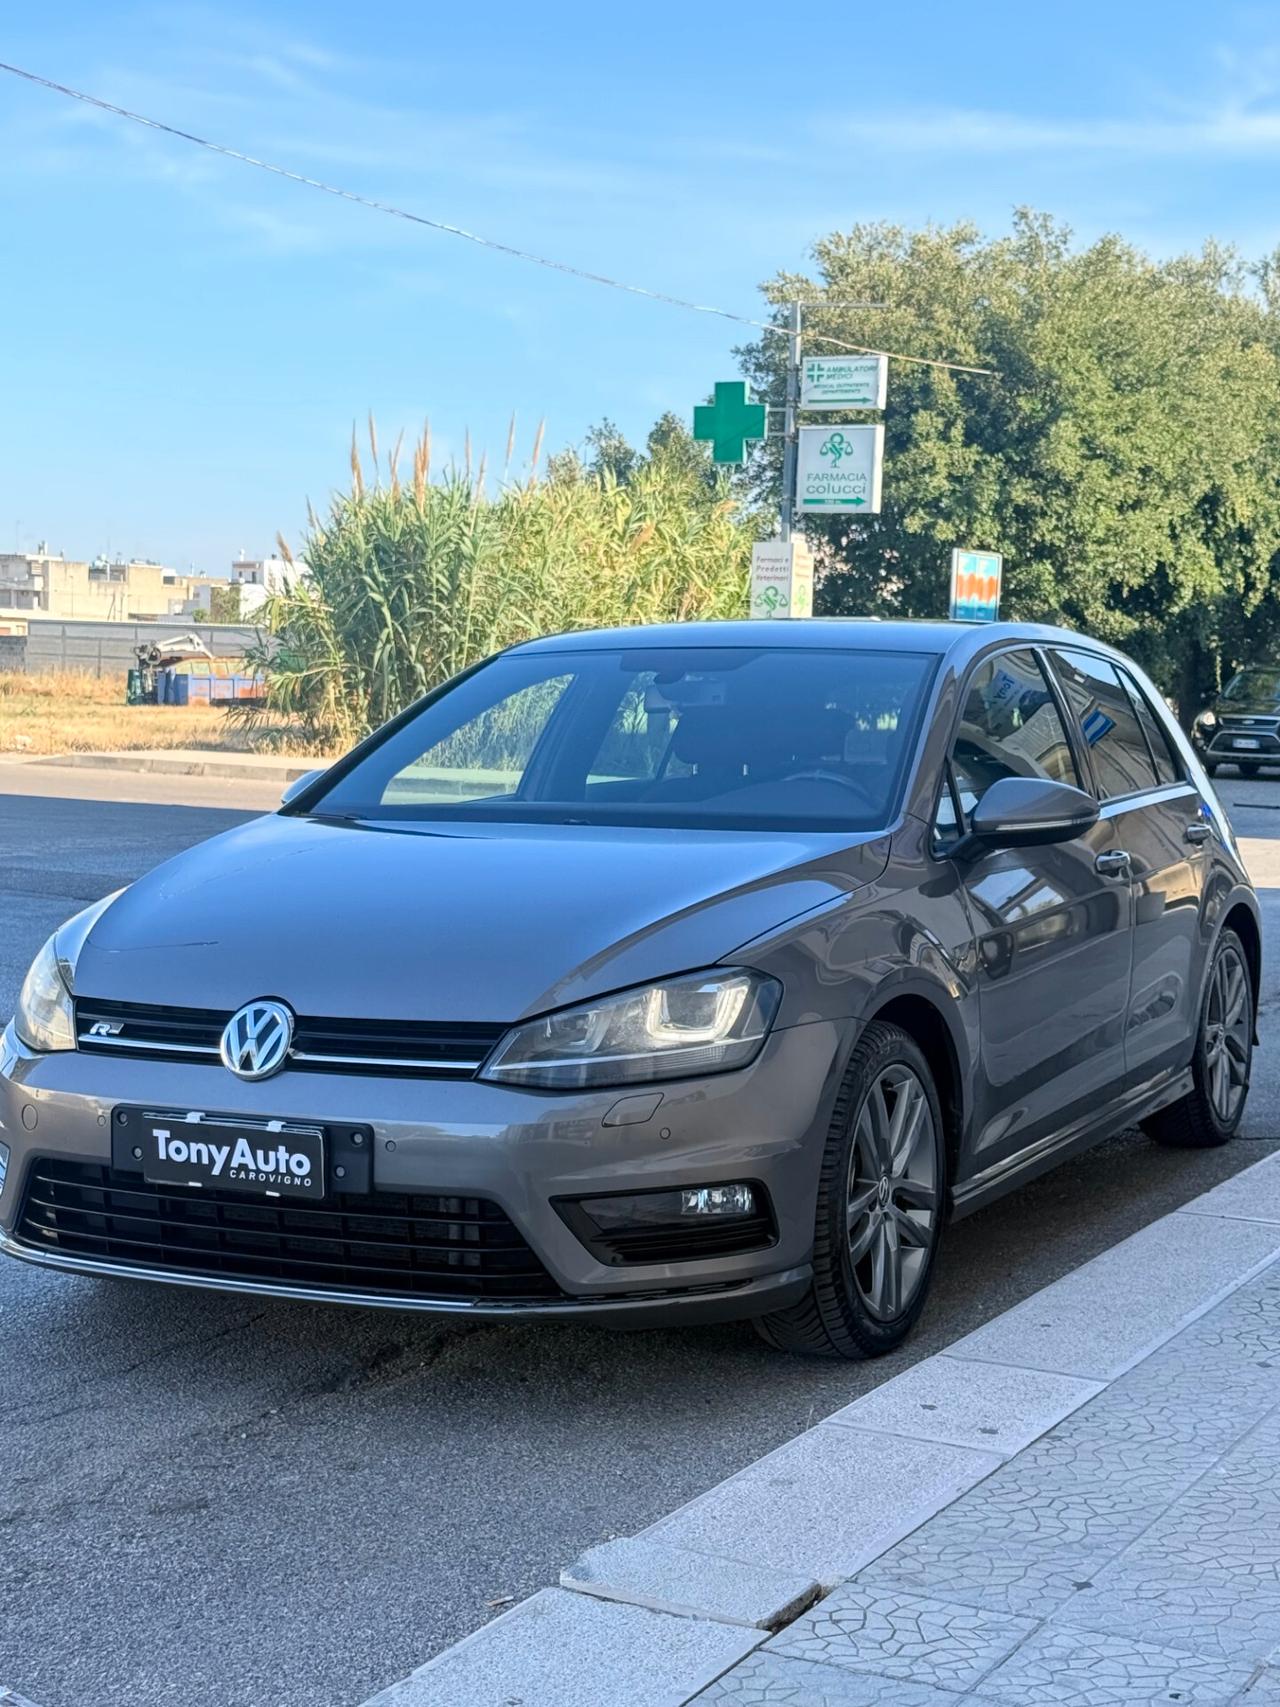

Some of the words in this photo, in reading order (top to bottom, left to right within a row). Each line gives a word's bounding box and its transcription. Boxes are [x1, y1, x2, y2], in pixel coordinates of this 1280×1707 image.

[807, 472, 867, 481] FARMACIA
[806, 482, 866, 494] colucci
[152, 1128, 311, 1176] TonyAuto
[229, 1170, 312, 1187] CAROVIGNO
